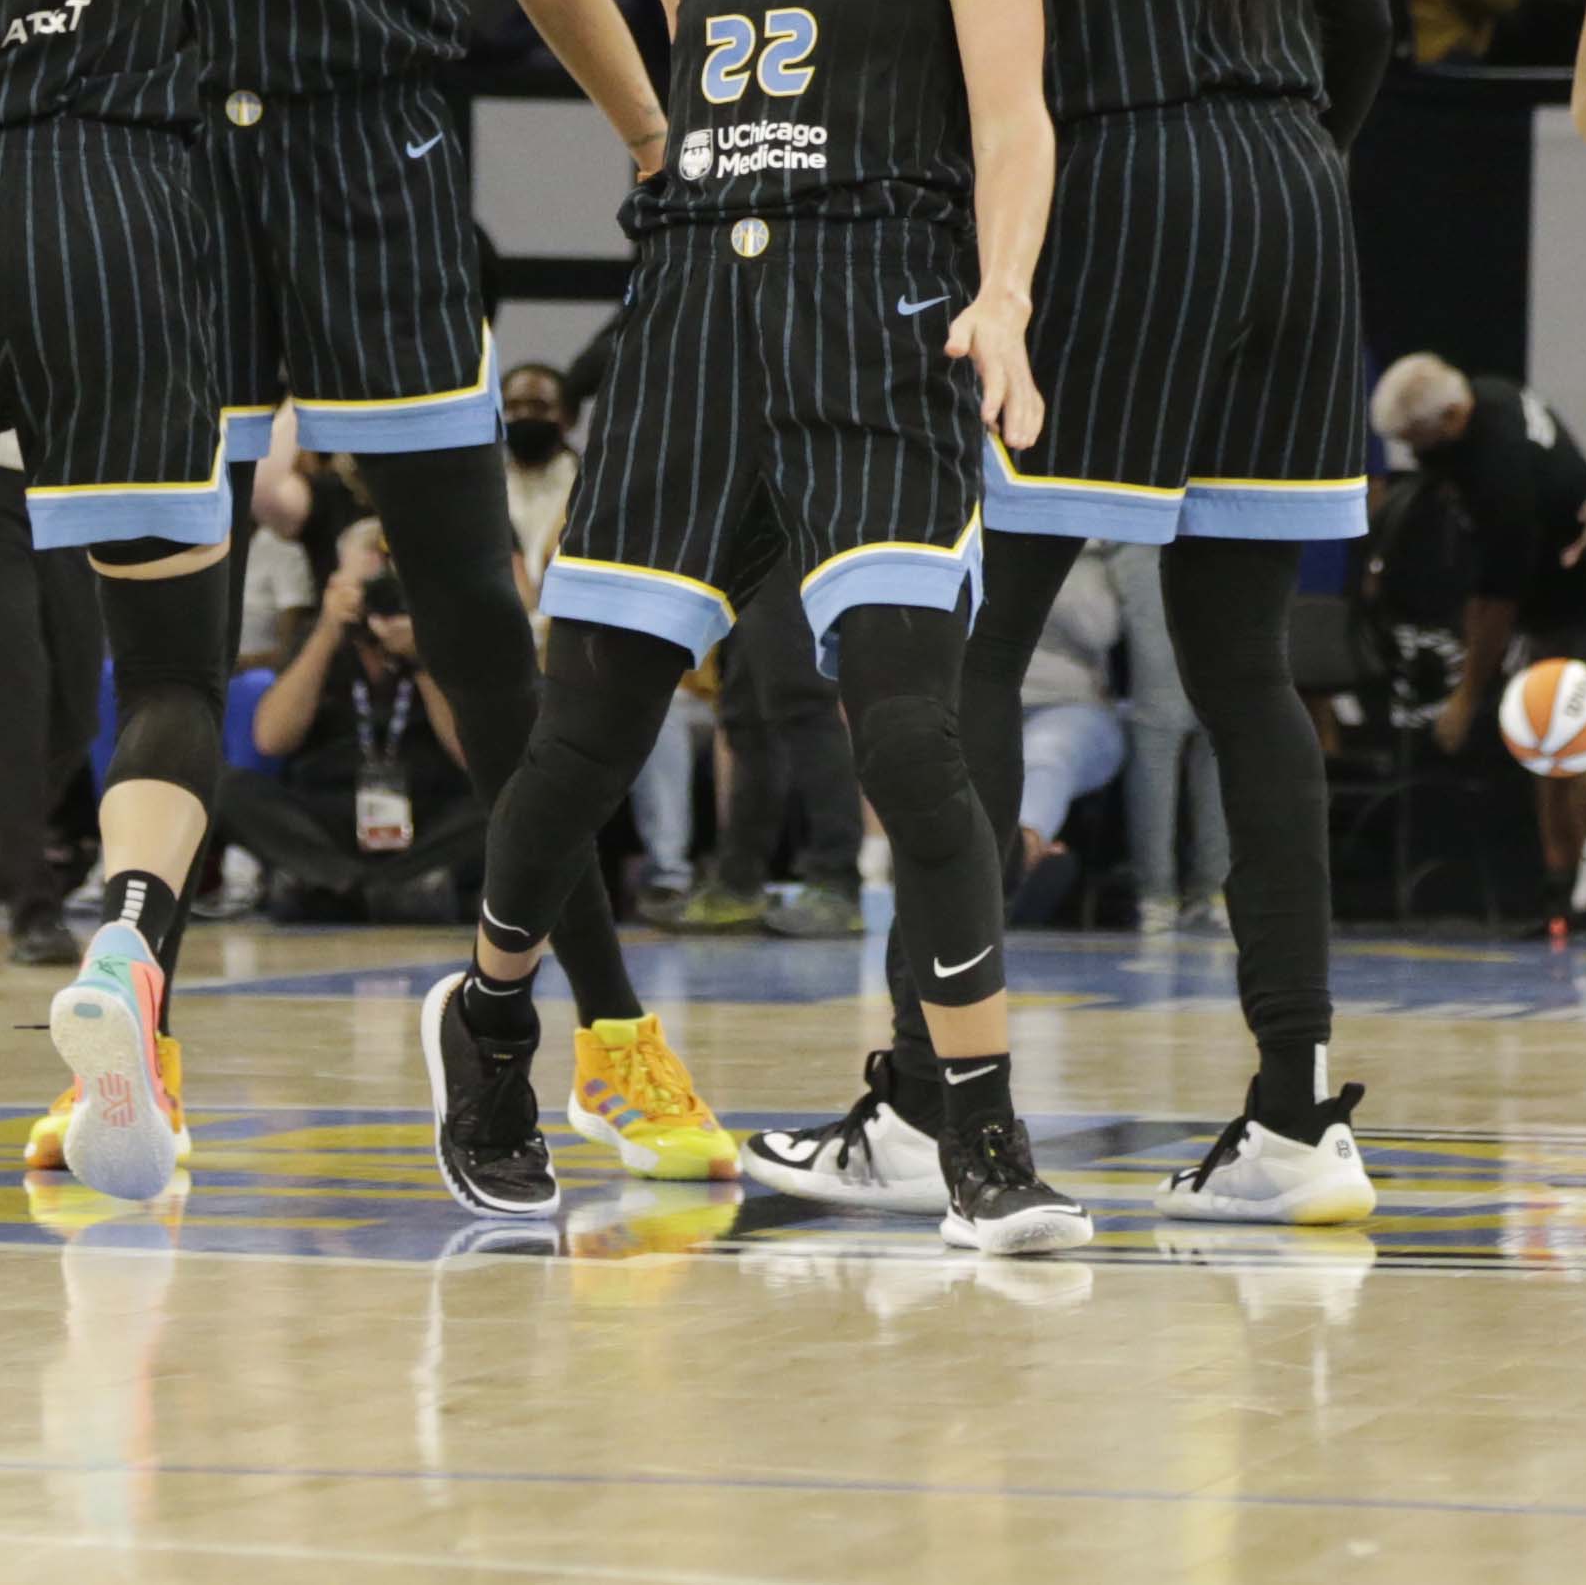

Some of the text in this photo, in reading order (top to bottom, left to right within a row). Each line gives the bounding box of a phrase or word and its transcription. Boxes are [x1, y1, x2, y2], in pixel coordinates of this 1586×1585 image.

[701, 6, 819, 105] 22
[718, 120, 828, 150] UChicago
[716, 145, 828, 179] Medicine
